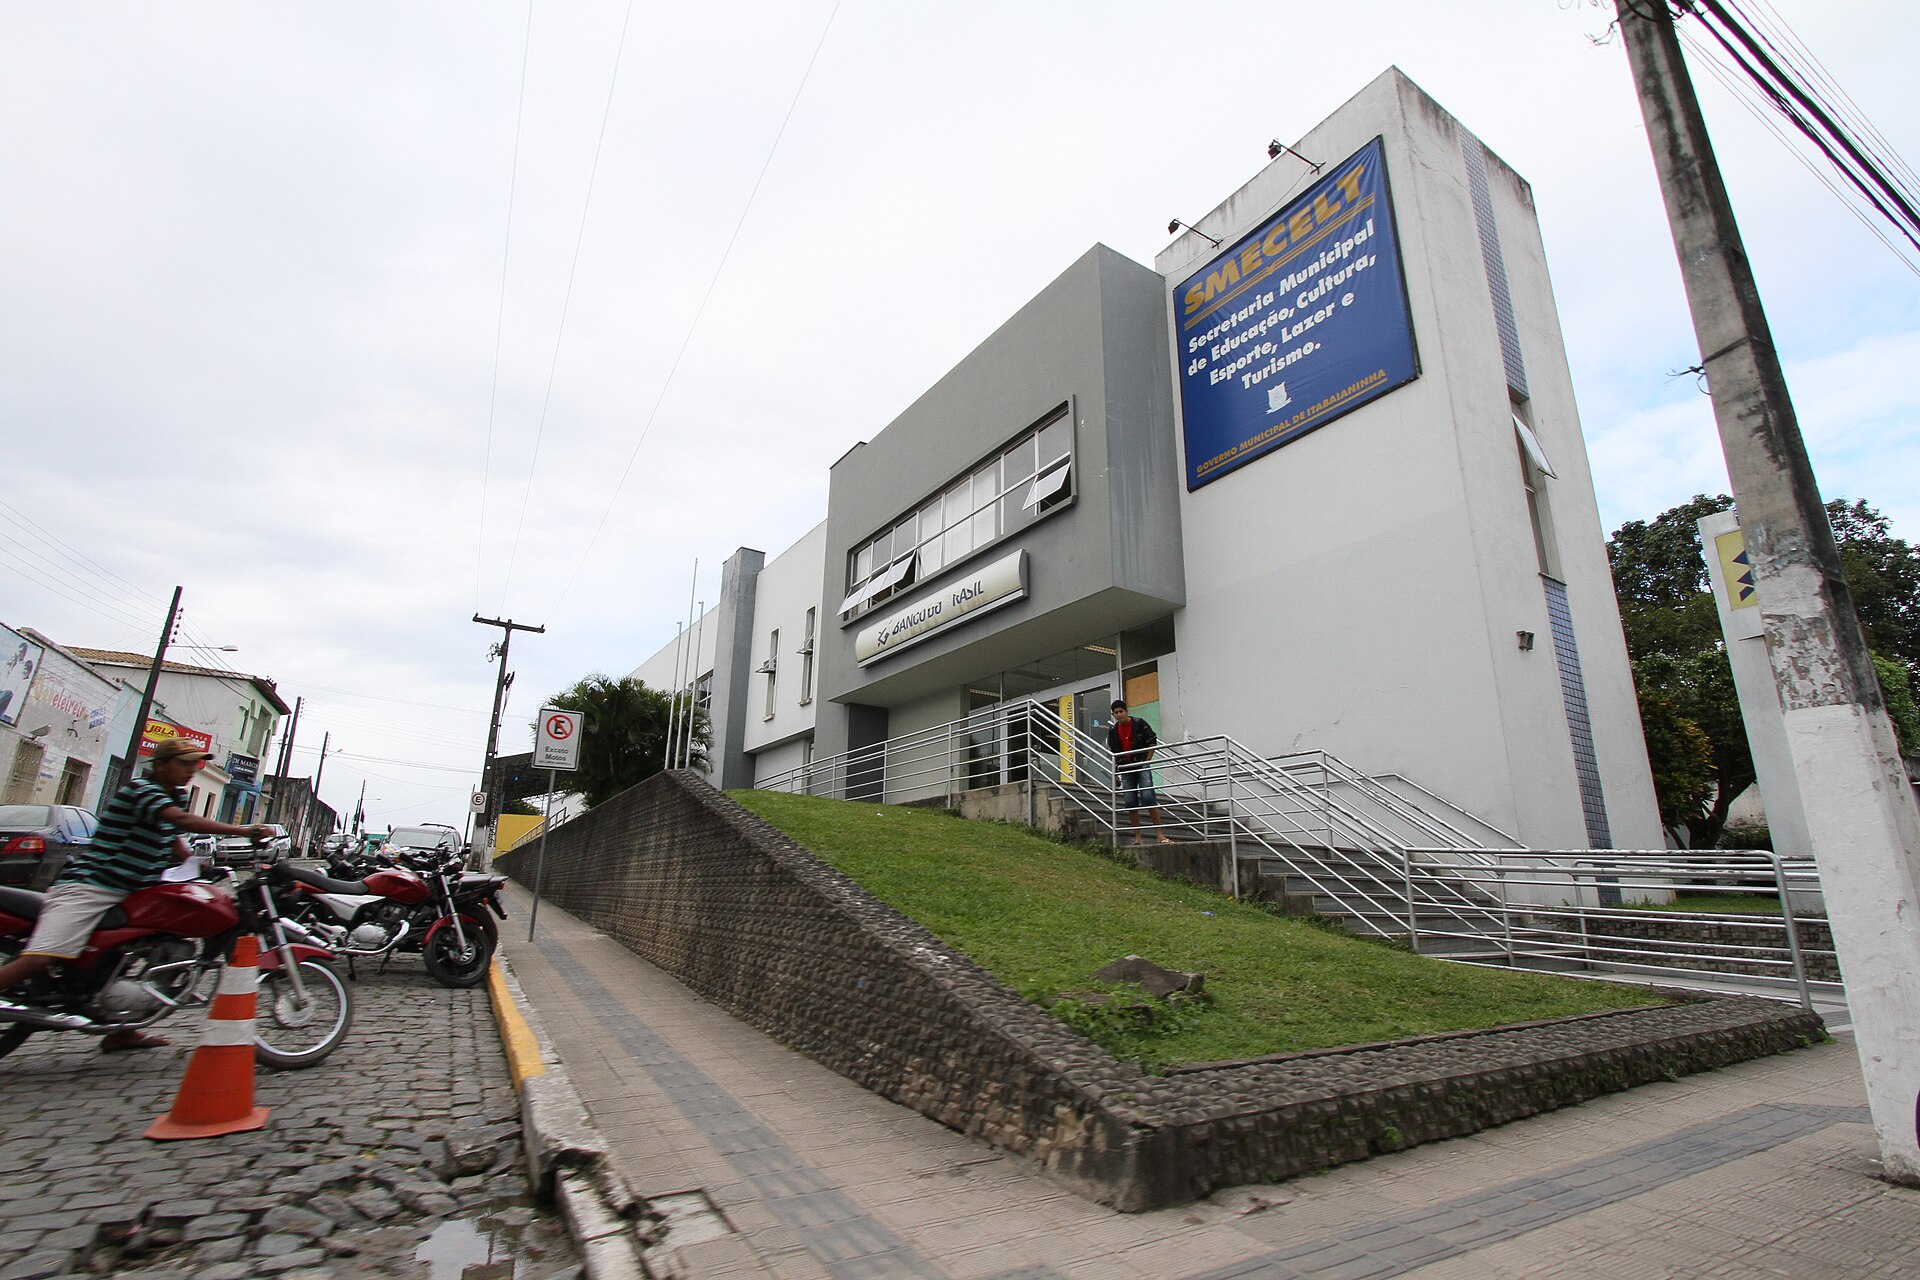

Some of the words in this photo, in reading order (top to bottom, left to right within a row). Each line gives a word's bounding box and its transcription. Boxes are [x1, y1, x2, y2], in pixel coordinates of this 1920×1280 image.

[1184, 163, 1365, 315] SMECELT
[1189, 291, 1274, 354] Secretaria
[1280, 218, 1374, 297] Municipal
[1188, 357, 1207, 376] de
[1211, 307, 1295, 361] Educação,
[1296, 254, 1376, 309] Cultura,
[1210, 341, 1278, 386] Esporte,
[1281, 301, 1335, 343] Lazer
[1341, 292, 1354, 307] e
[1242, 341, 1321, 390] Turismo.
[1196, 446, 1237, 473] GOVERNO
[1239, 419, 1291, 451] MUNICIPAL
[1292, 410, 1305, 424] DE
[1306, 368, 1386, 417] ITABAIANINHA
[544, 745, 569, 754] Exceto
[545, 753, 567, 761] Motos
